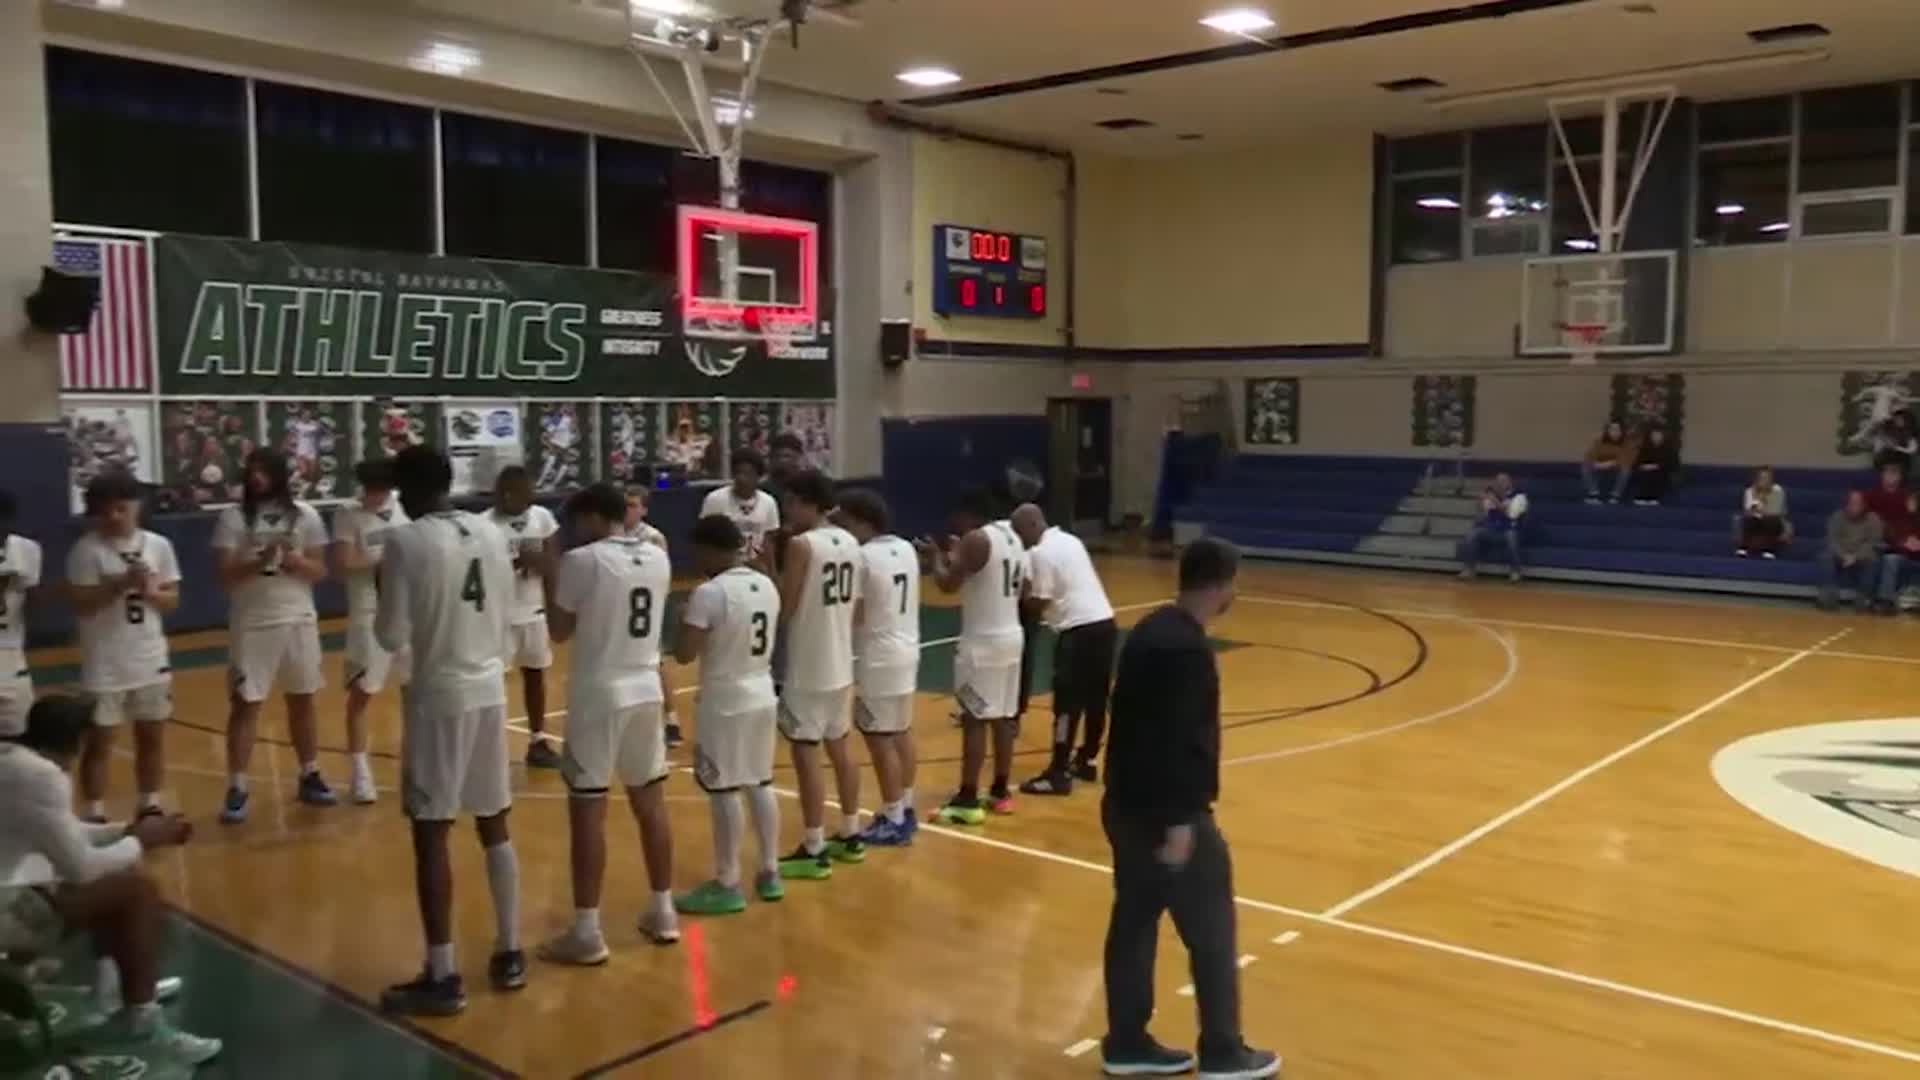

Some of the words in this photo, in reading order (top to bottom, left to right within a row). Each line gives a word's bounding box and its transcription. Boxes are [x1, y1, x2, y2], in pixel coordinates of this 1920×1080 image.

[962, 279, 977, 307] 0
[179, 281, 587, 381] ATHLETICS
[462, 558, 486, 612] 4
[822, 562, 854, 605] 20
[893, 573, 908, 614] 7
[1001, 558, 1021, 598] 14
[629, 586, 652, 638] 8
[751, 611, 768, 656] 3
